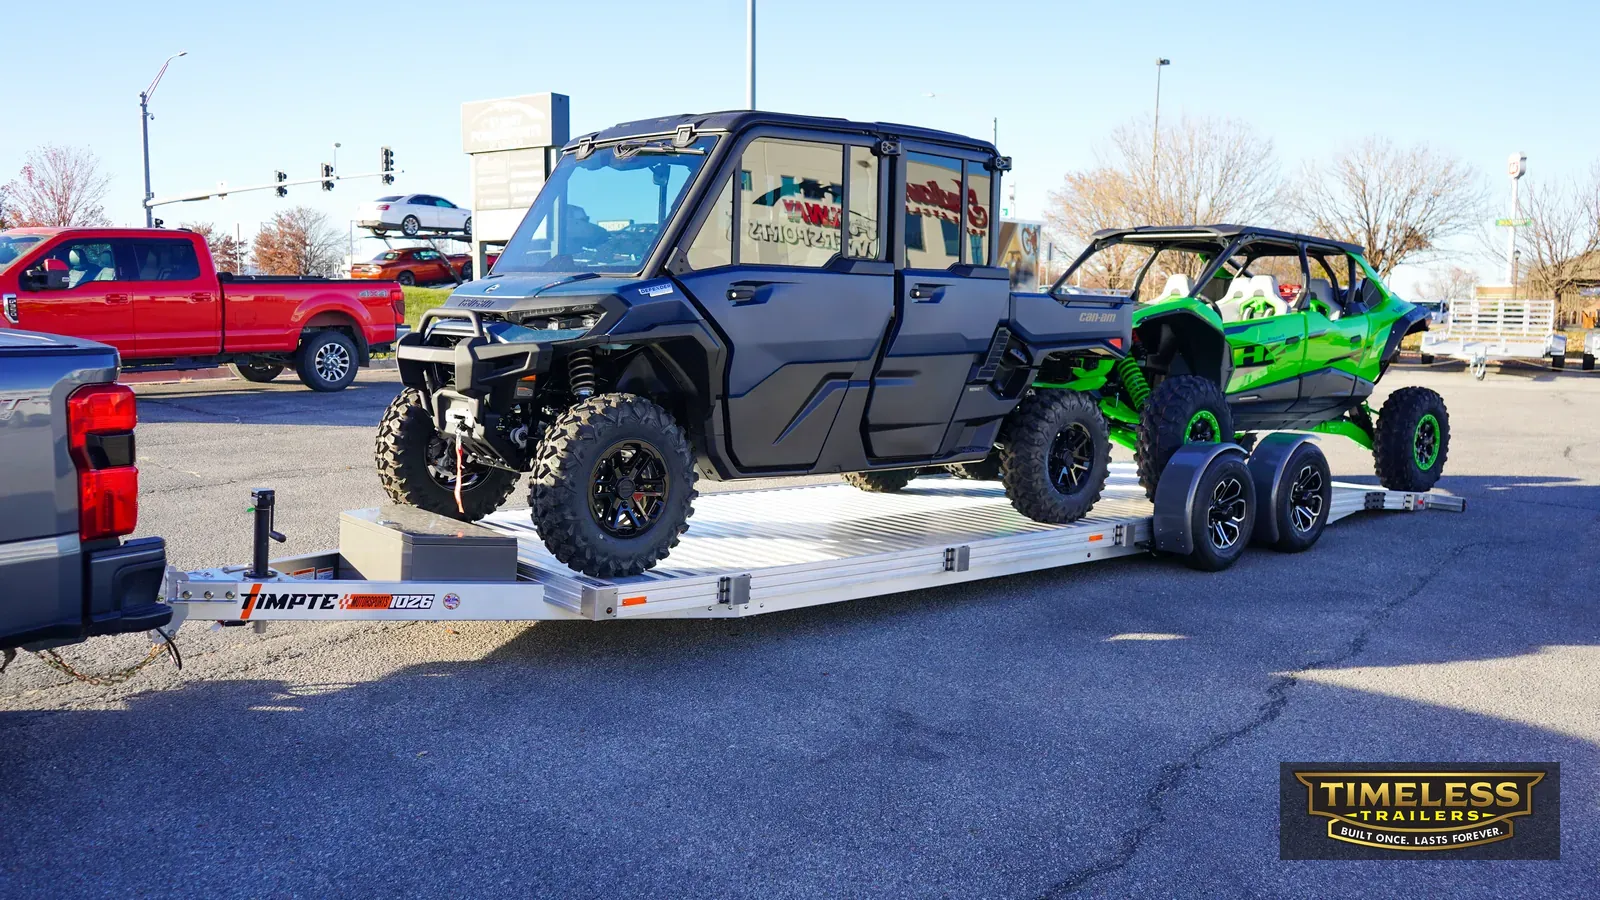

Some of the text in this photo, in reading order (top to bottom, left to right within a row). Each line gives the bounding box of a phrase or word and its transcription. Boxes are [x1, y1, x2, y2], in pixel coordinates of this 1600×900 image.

[240, 587, 339, 614] TIMPTE
[351, 594, 390, 608] MOTORSPORTS
[390, 595, 434, 608] 1026
